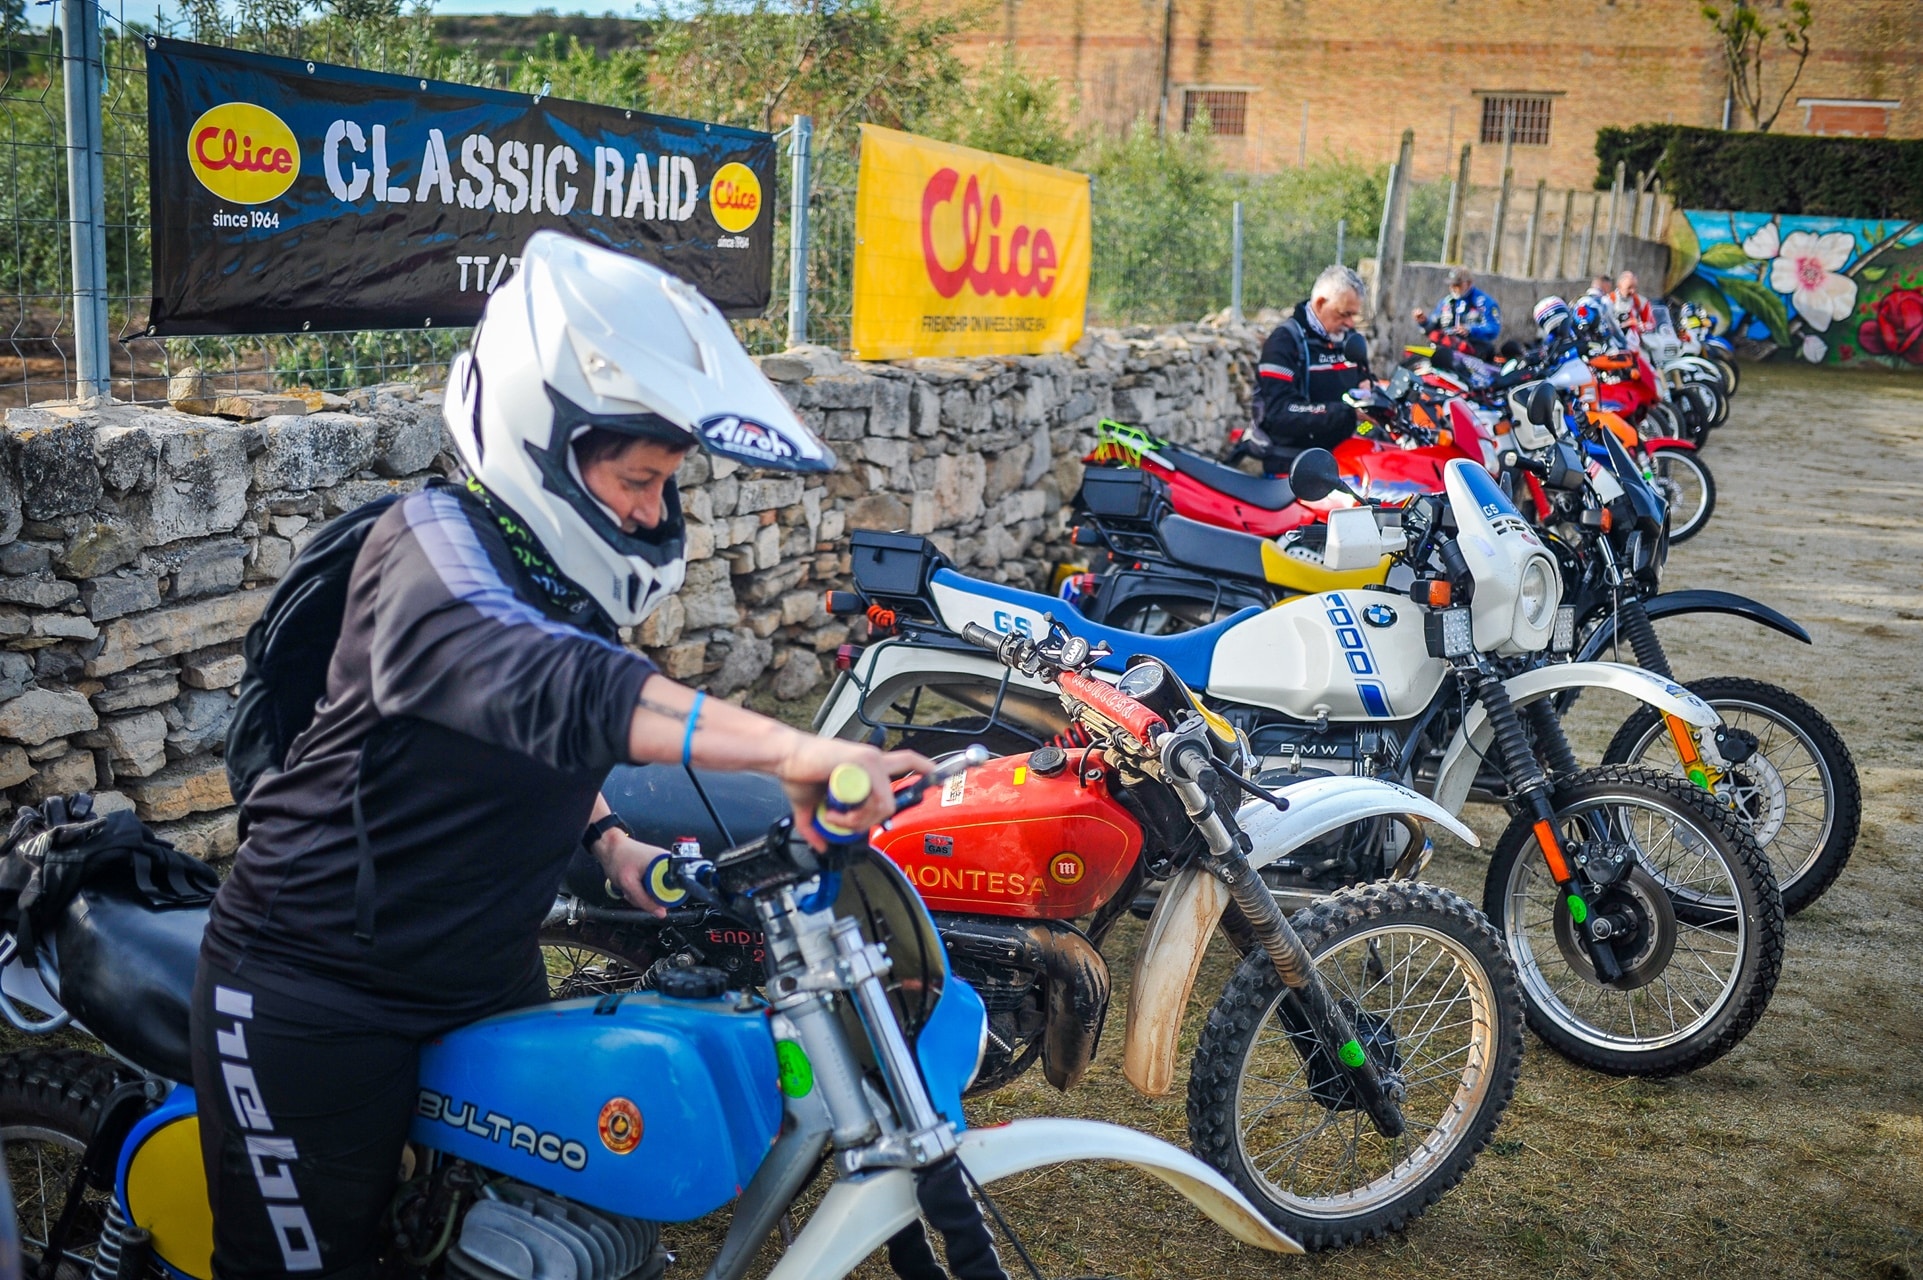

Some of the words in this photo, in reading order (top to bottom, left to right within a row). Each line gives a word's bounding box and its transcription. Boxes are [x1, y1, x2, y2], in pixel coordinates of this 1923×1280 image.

[195, 126, 293, 174] Clice
[323, 119, 579, 216] CLASSIC
[591, 146, 699, 221] RAID
[715, 180, 757, 210] Clice
[212, 209, 249, 228] since
[250, 211, 280, 229] 1964
[921, 167, 1057, 299] Clice
[705, 416, 792, 457] Airoh
[1483, 503, 1500, 517] GS
[994, 610, 1033, 641] GS
[1326, 593, 1374, 675] 1000
[1280, 743, 1338, 754] BMW
[927, 844, 949, 855] GAS
[903, 864, 1049, 897] MONTESA
[416, 1089, 588, 1171] BULTACO
